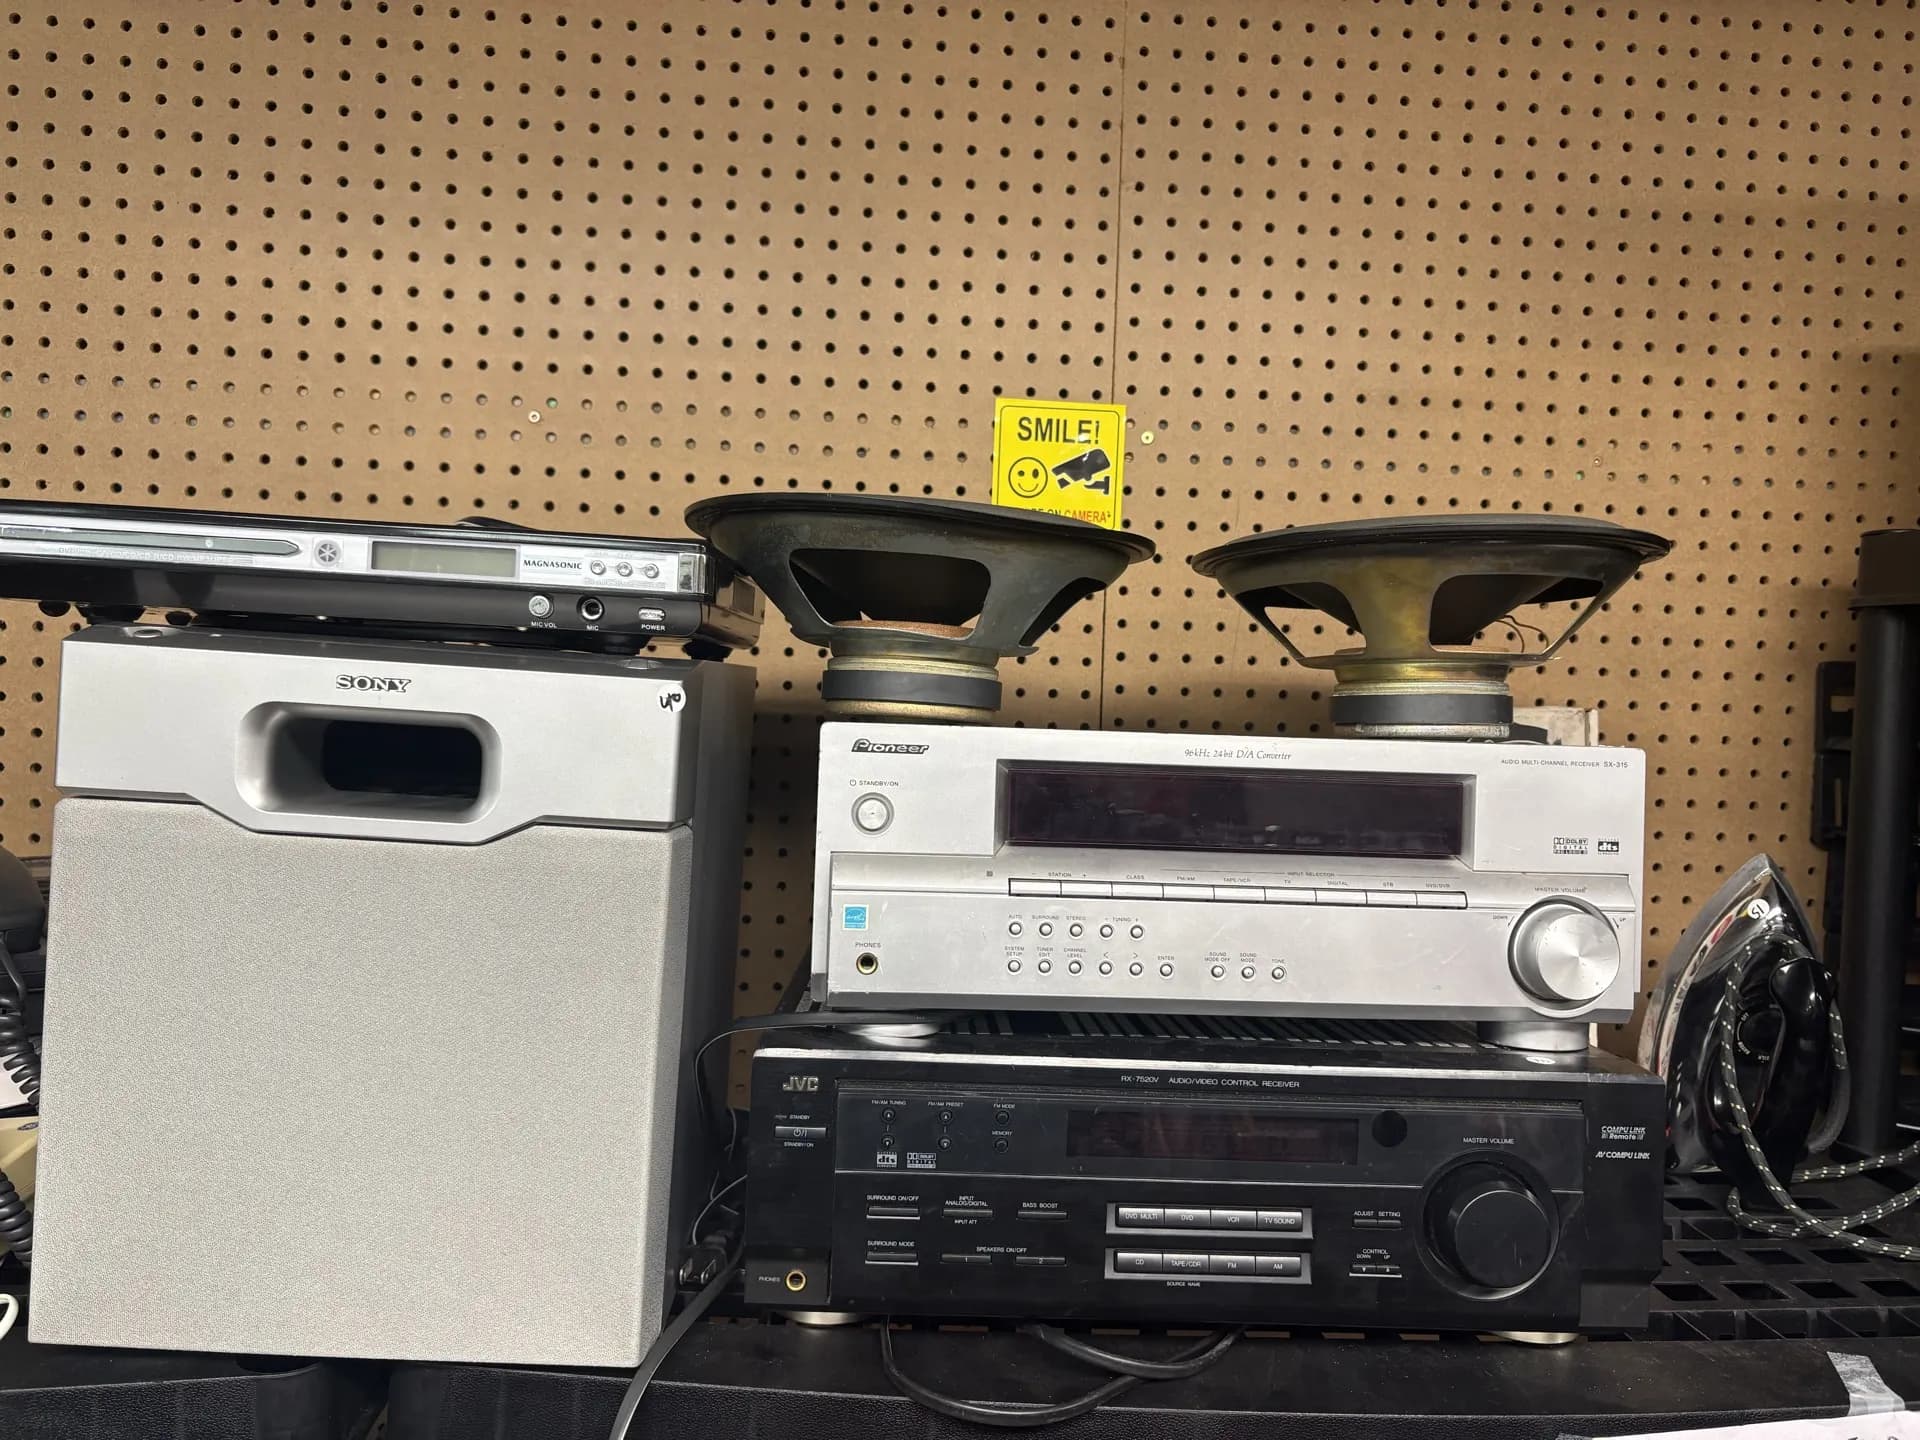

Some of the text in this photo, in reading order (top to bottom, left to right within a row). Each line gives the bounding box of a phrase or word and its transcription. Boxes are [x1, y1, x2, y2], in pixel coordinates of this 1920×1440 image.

[1017, 416, 1100, 445] SMILE!
[523, 559, 582, 570] MAGNASONIC
[641, 623, 666, 632] POWER
[335, 674, 411, 693] SONY
[852, 738, 930, 755] Pioneer
[1236, 748, 1254, 759] D/A
[1256, 750, 1292, 761] Converter
[1501, 758, 1520, 766] AUDIO
[1603, 760, 1629, 769] SX-315
[858, 779, 899, 787] STANDBY/ON
[782, 1075, 820, 1092] JVC
[1120, 1074, 1300, 1089] RX-7520V AUDIO/VIDEO CONTROL RECEIVER
[1600, 1125, 1646, 1134] COMPU LINK
[1462, 1136, 1515, 1145] MASTER VOLUME
[1608, 1133, 1637, 1141] Remote
[878, 1154, 896, 1163] dts
[1605, 1151, 1633, 1159] COMPU
[1633, 1152, 1651, 1160] LINK
[1125, 1212, 1158, 1220] DVD MULTI
[1180, 1214, 1194, 1222] DVD
[1264, 1217, 1296, 1225] TV SOUND
[1135, 1258, 1145, 1266] CD
[1171, 1258, 1202, 1268] TAPE/CDR
[1227, 1262, 1238, 1270] FM
[1272, 1263, 1284, 1271] AM
[758, 1275, 781, 1283] PHONES
